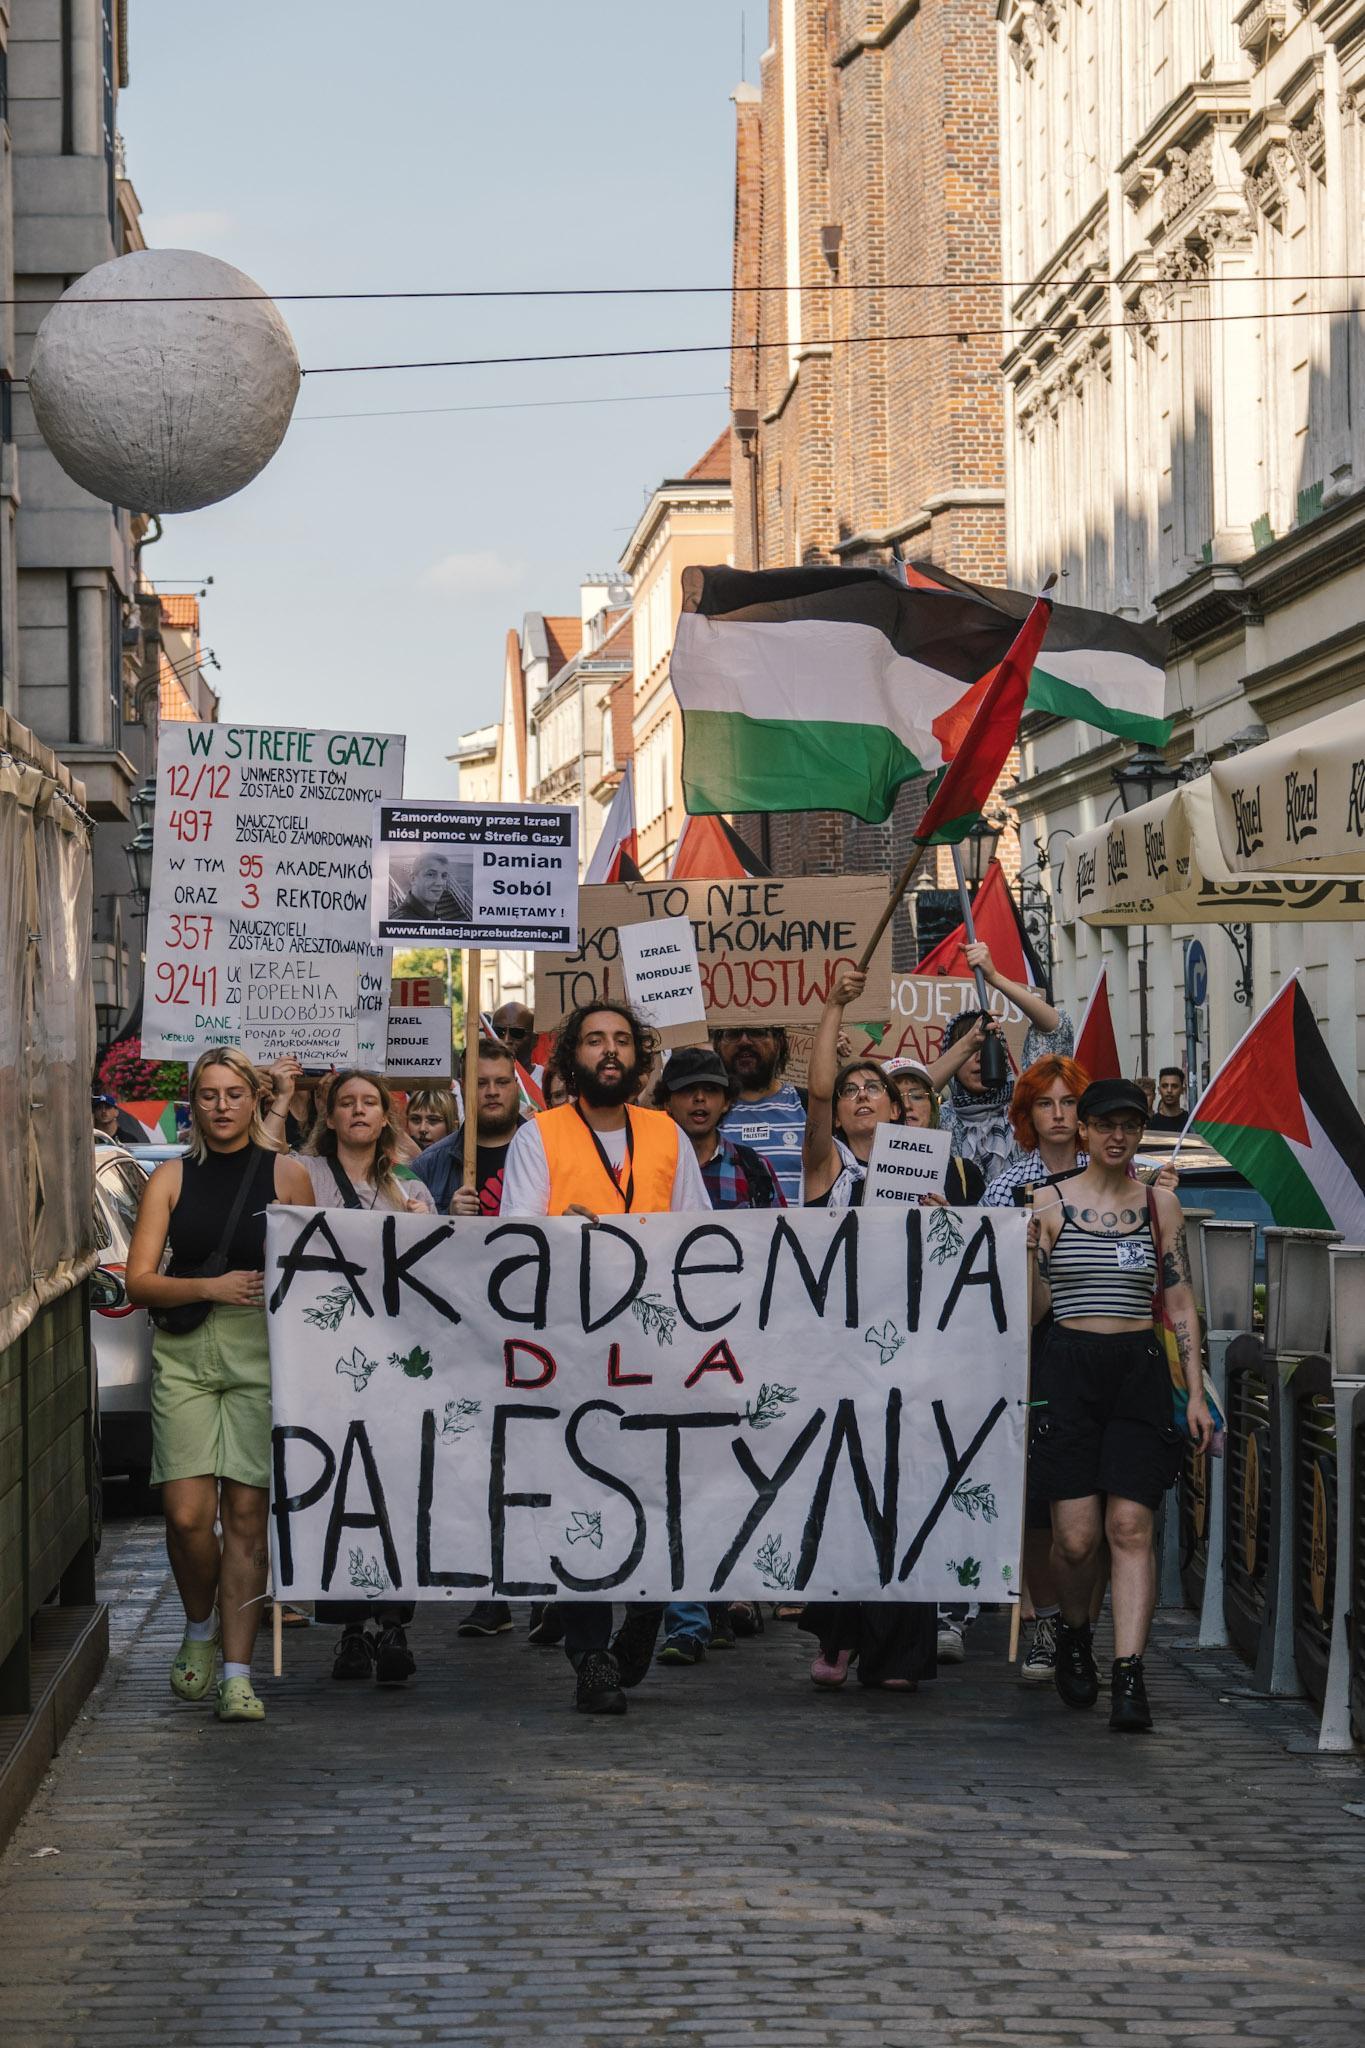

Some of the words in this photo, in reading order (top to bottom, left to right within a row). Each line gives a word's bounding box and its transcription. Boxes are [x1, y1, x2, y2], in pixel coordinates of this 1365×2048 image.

[187, 728, 214, 757] W
[225, 728, 315, 764] STREFIE
[327, 734, 389, 767] GAZY
[167, 764, 231, 800] 12/12
[240, 767, 347, 786] UNIWERSYTETÓW
[239, 783, 294, 799] ZOSTAŁO
[300, 785, 382, 803] ZNISZCZONYCH
[1285, 768, 1317, 845] Kozel
[169, 810, 213, 843] 497
[236, 813, 308, 830] NAUCZYCIELI
[392, 811, 483, 827] Zamordowany
[486, 815, 521, 827] przez
[524, 815, 560, 827] Izrael
[1232, 785, 1262, 858] Kozel
[236, 828, 287, 844] ZOSTAŁO
[290, 830, 373, 849] ZAMORDOWANY
[388, 828, 420, 840] niósł
[422, 830, 466, 842] pomoc
[469, 832, 481, 841] w
[484, 831, 528, 843] Strefie
[531, 832, 564, 846] Gazy
[1144, 819, 1166, 880] Kozel
[169, 858, 186, 871] W
[194, 858, 225, 873] TYM
[238, 855, 264, 879] 95
[483, 852, 562, 869] Damian
[174, 886, 217, 904] ORAZ
[241, 883, 260, 909] 3
[276, 888, 367, 911] REKTORÓW
[492, 879, 551, 897] Soból
[637, 886, 689, 918] TO
[707, 884, 785, 917] NIE
[479, 906, 557, 920] PAMIĘTAMY
[560, 908, 566, 918] !
[165, 914, 213, 951] 357
[229, 919, 306, 937] NAUCZYCIELI
[385, 925, 563, 940] www.fundacjaprzebudzenie.pl
[228, 934, 284, 953] ZOSTAŁO
[640, 944, 681, 959] IZRAEL
[250, 961, 320, 979] IZRAEL
[636, 964, 693, 982] MORDUJE
[155, 961, 217, 1007] 9241
[248, 984, 338, 1001] POPEŁNIA
[545, 970, 597, 1014] TO
[641, 986, 694, 1004] LEKARZY
[195, 1014, 231, 1029] DANE
[246, 1004, 358, 1021] LUDOBÓJSTWO
[388, 1016, 422, 1025] ZRAEL
[204, 1035, 241, 1046] MINISTE
[245, 1029, 286, 1039] PONAD
[387, 1037, 429, 1045] ORDUJE
[264, 1039, 340, 1048] ZAMORDOWANYCH
[387, 1057, 442, 1066] NNIKARZY
[889, 1139, 933, 1154] IZRAEL
[876, 1163, 939, 1180] MORDUJE
[876, 1189, 926, 1203] KOBIET
[504, 1338, 744, 1389] DLA
[271, 1388, 1008, 1597] PALESTYNY
